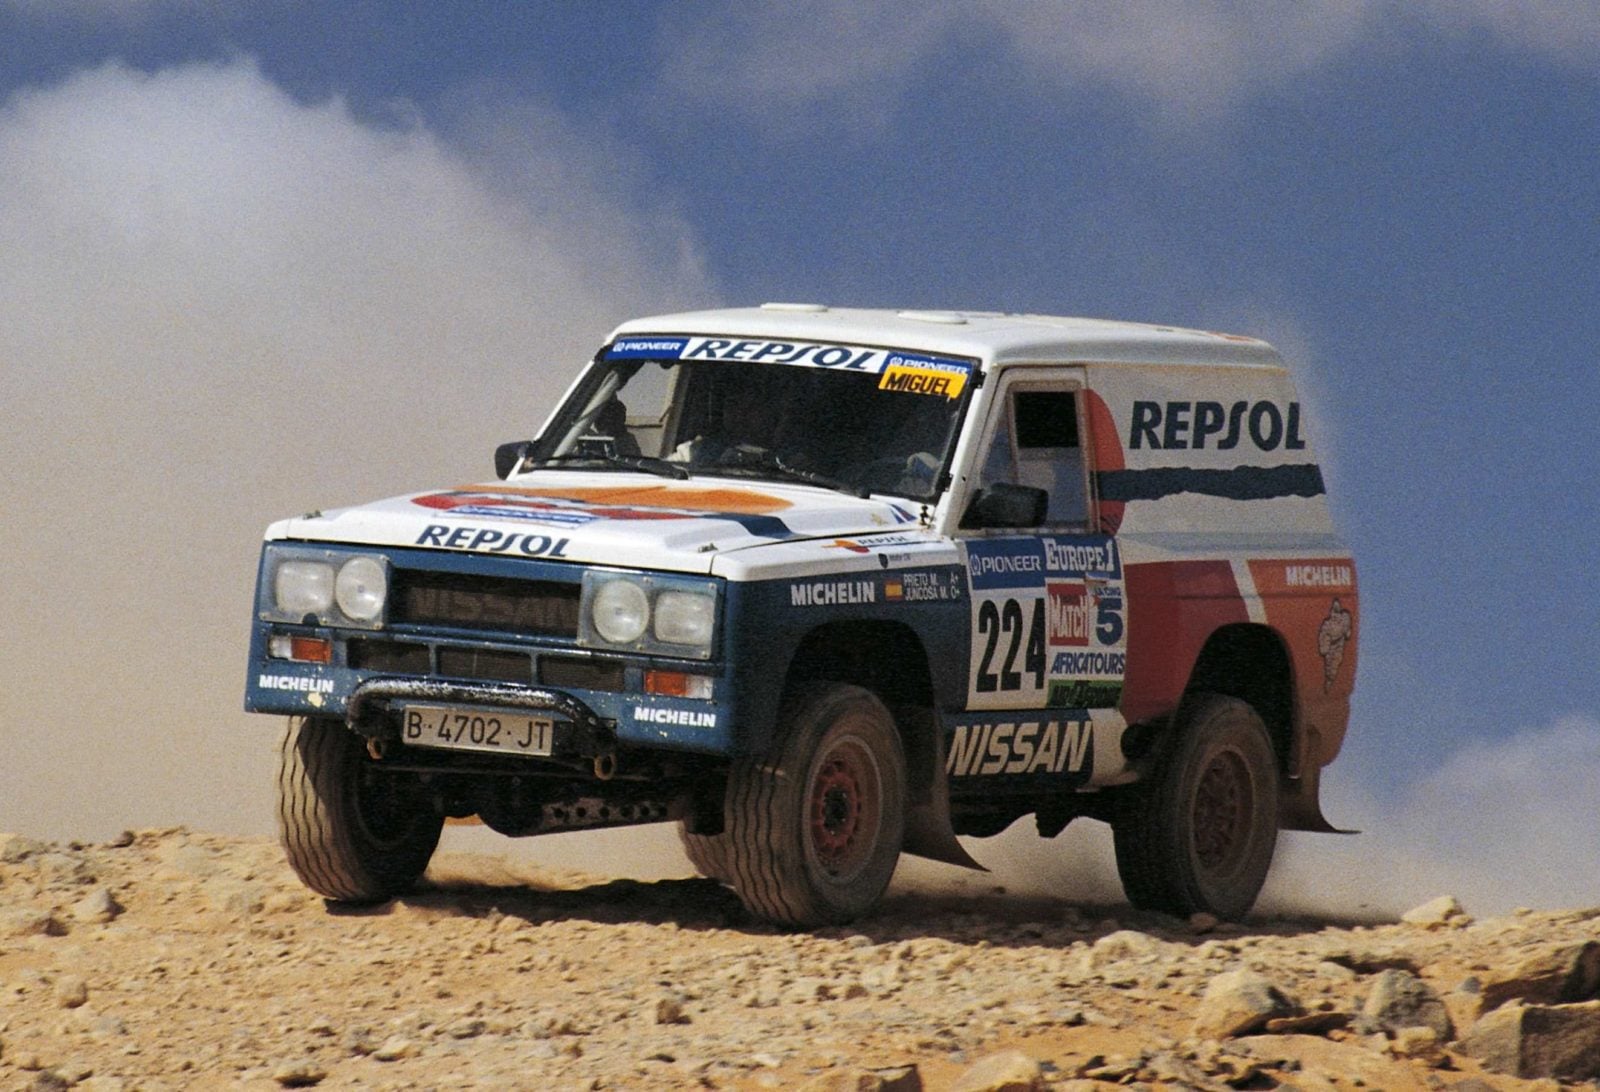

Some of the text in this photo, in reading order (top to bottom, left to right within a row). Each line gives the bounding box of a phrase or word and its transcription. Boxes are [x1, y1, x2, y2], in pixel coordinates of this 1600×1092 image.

[624, 341, 682, 351] PIONEER
[687, 339, 879, 370] REPSOL
[884, 371, 952, 396] MIGUEL
[1129, 400, 1305, 451] REPSOL
[415, 524, 571, 558] REPSOL
[982, 555, 1042, 572] PIONEER
[1285, 565, 1352, 586] MICHELIN
[791, 581, 875, 606] MICHELIN
[1096, 598, 1123, 646] 5
[976, 598, 1046, 693] 224
[1051, 652, 1125, 675] AFRICATOURS
[259, 673, 334, 694] MICHELIN
[634, 706, 717, 728] MICHELIN
[945, 720, 1093, 776] NISSAN
